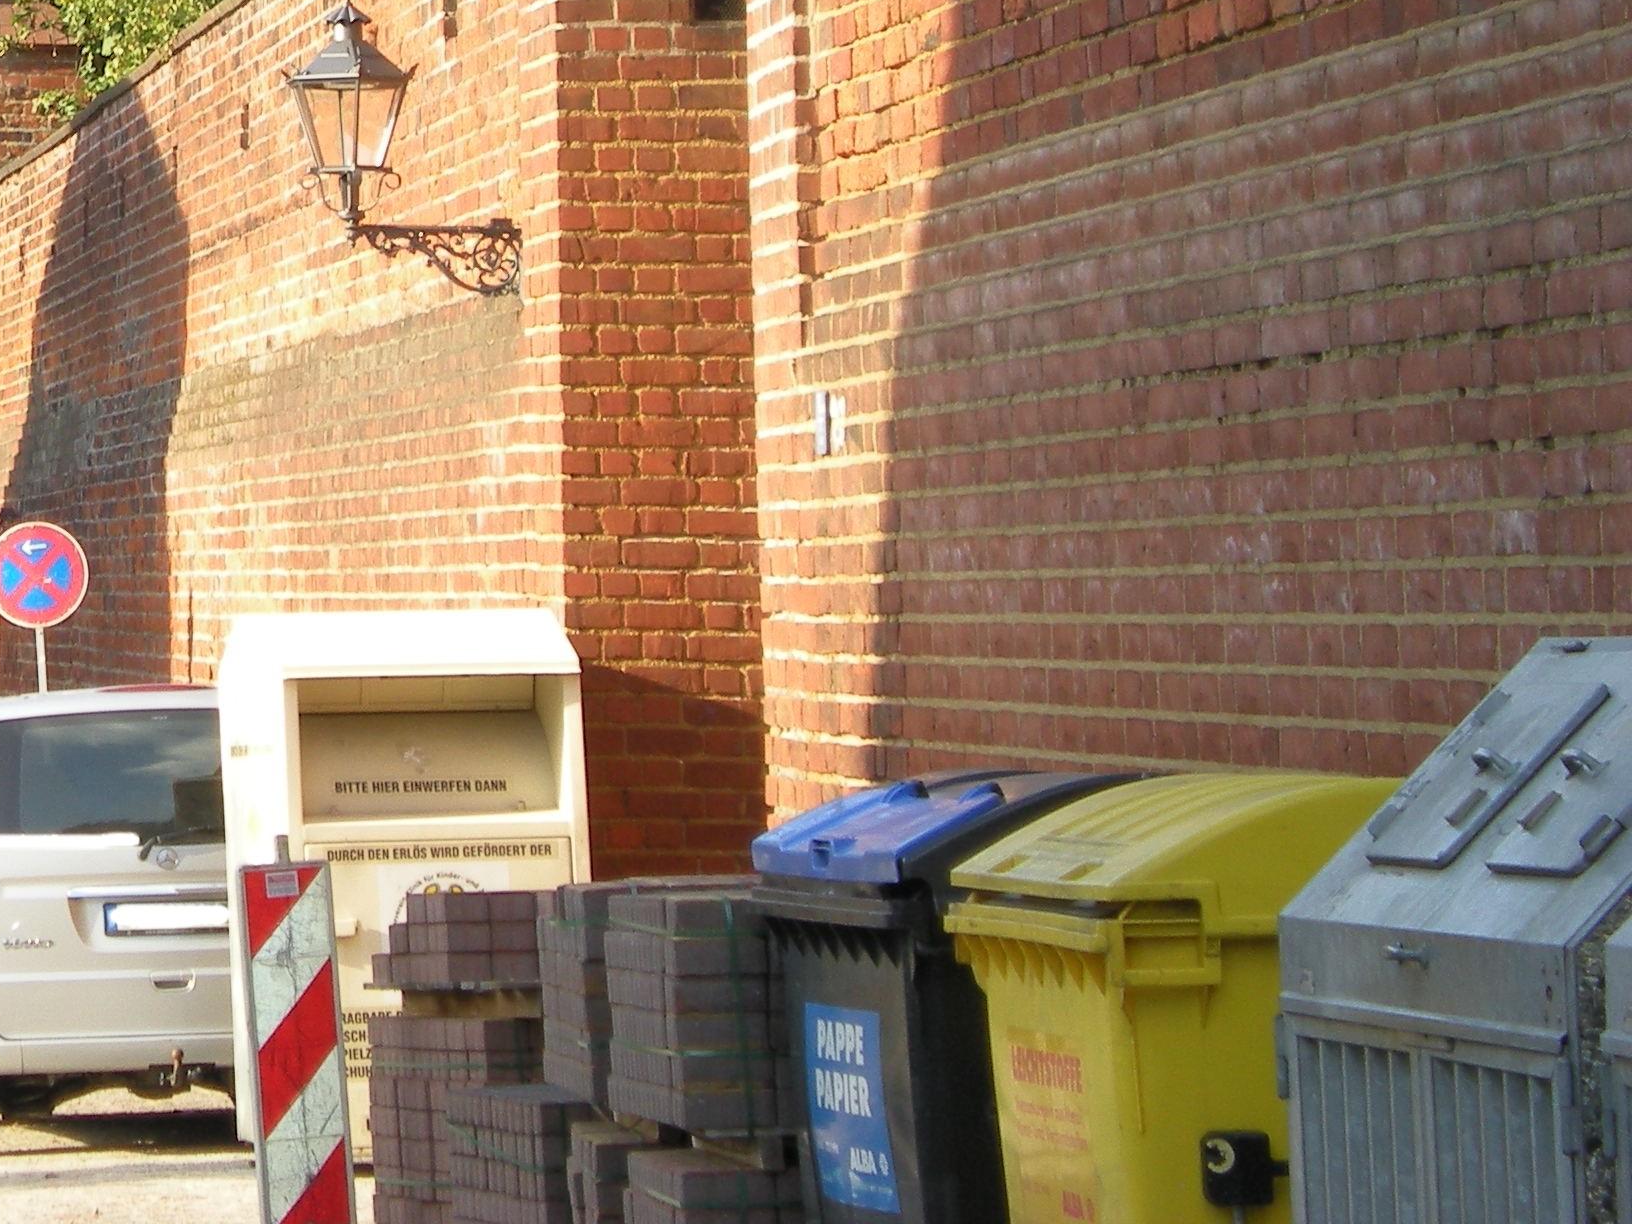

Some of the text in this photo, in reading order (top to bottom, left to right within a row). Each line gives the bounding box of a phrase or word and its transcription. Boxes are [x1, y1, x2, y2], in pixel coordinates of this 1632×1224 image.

[334, 779, 507, 794] BITTE HIER EINWERFEN DANN
[327, 842, 551, 862] DURCH DEN ERLÖS WIRD GEFÖRDERT DER
[816, 1019, 864, 1066] PAPPE
[815, 1069, 872, 1117] PAPIER
[849, 1147, 878, 1174] ALBA
